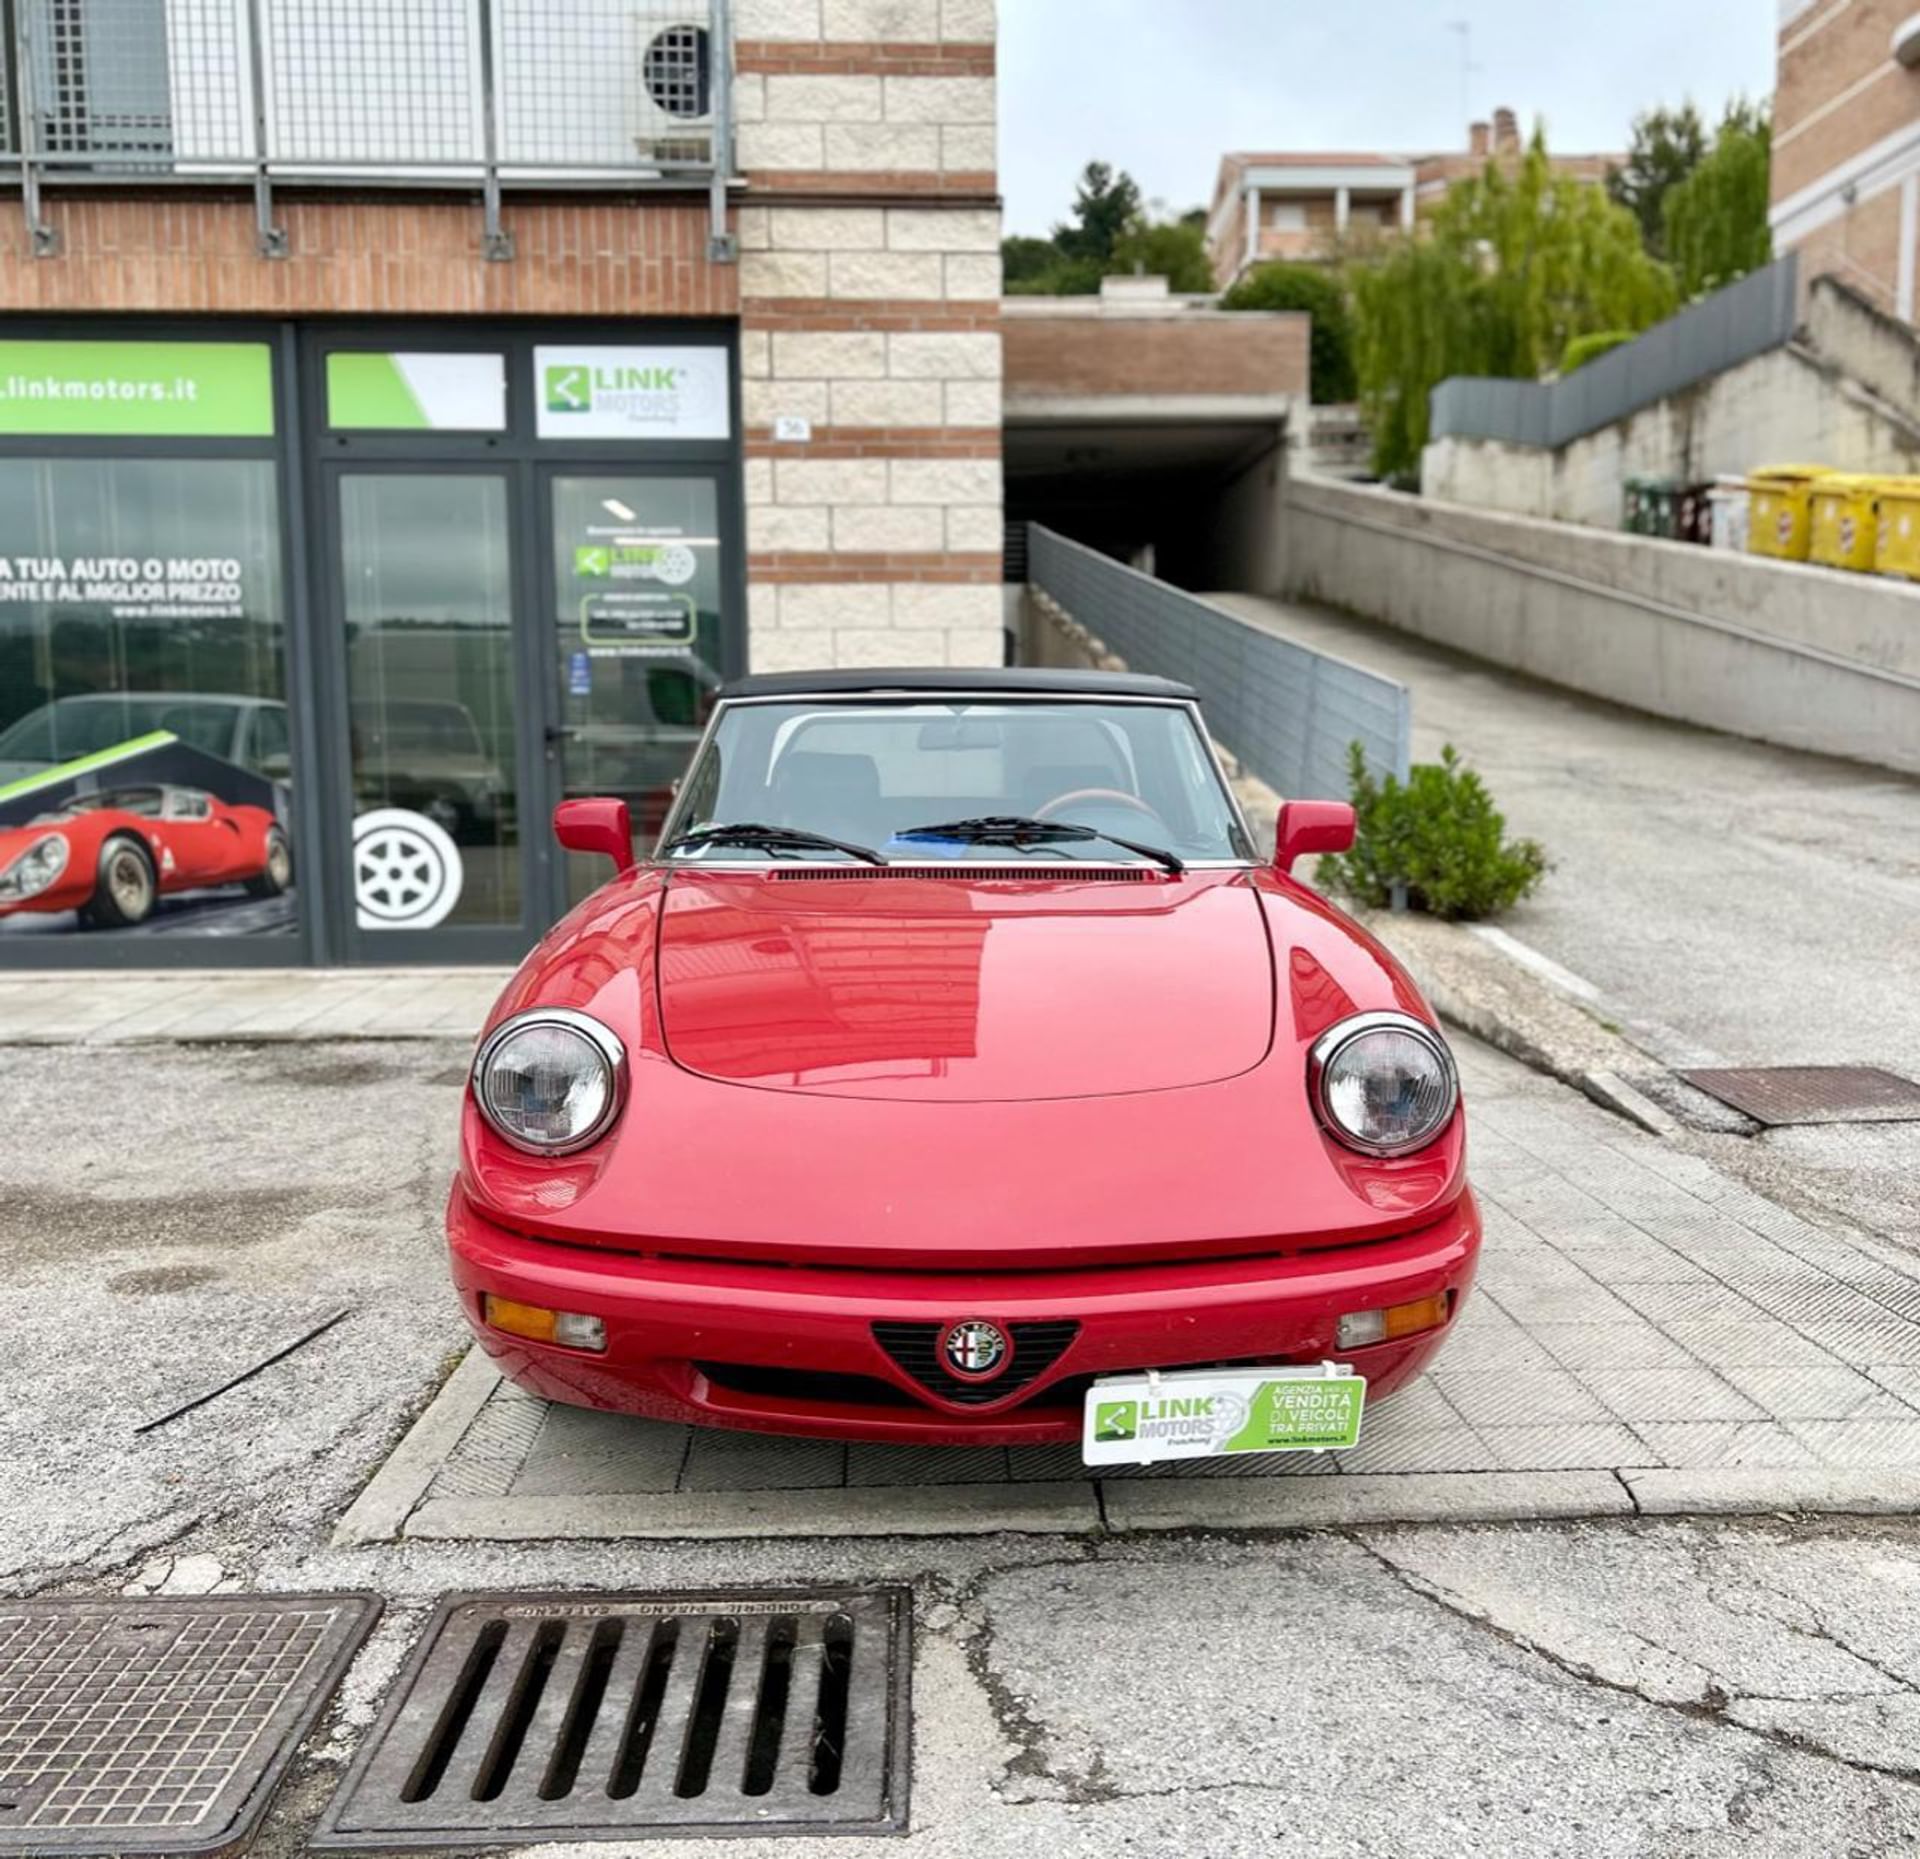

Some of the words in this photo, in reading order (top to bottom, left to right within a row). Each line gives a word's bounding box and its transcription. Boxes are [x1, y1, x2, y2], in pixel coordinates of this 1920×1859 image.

[595, 367, 677, 390] LINK
[15, 558, 67, 580] TUA
[71, 558, 139, 581] AUTO
[142, 558, 164, 581] O
[167, 558, 241, 581] MOTO
[57, 582, 82, 601] AL
[85, 581, 166, 601] MIGLIOR
[168, 581, 242, 601] PREZZO
[1274, 1385, 1322, 1394] AGENZIA
[1141, 1397, 1214, 1420] LINK
[1272, 1393, 1351, 1409] VENDITA
[1289, 1408, 1351, 1422] VEICOLI
[1139, 1419, 1214, 1439] MOTORS
[1270, 1424, 1294, 1434] TRA
[1298, 1421, 1349, 1433] PRIVATI
